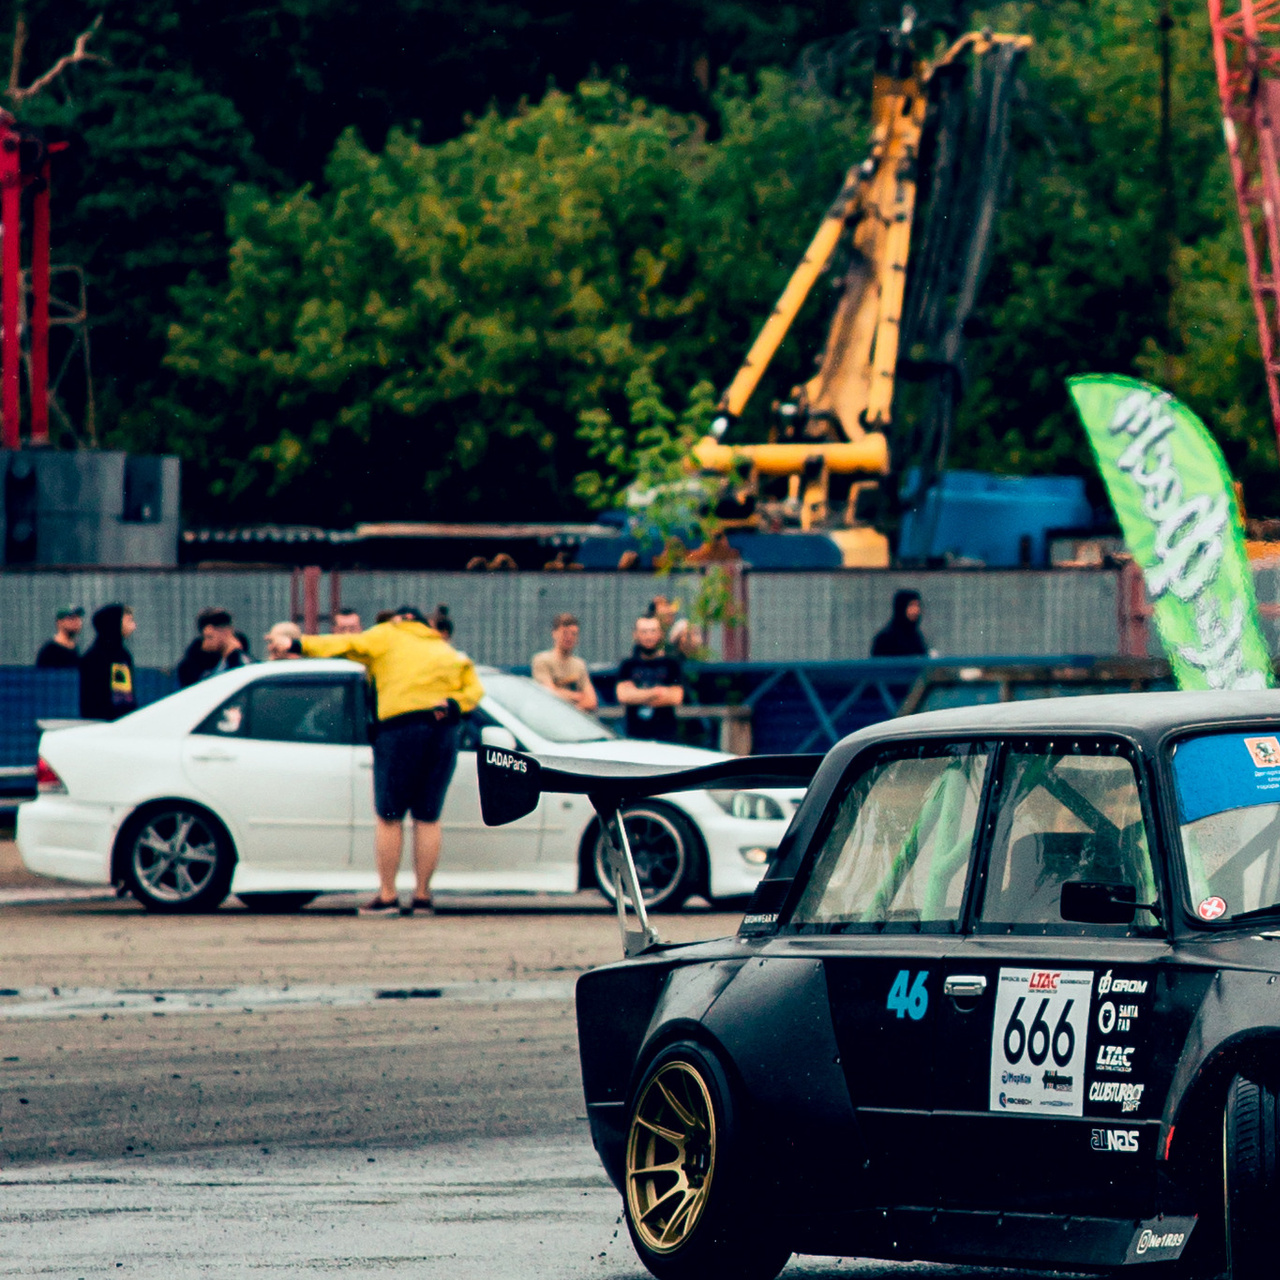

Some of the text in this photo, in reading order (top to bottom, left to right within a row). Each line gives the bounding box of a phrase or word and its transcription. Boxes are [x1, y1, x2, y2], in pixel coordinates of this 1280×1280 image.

[486, 749, 528, 773] LADAParts
[1029, 972, 1061, 990] LTAC
[1111, 979, 1148, 993] GROM
[887, 969, 930, 1021] 46
[1118, 1004, 1139, 1018] SANTA
[1003, 996, 1076, 1067] 666
[1096, 1045, 1135, 1067] LTAC
